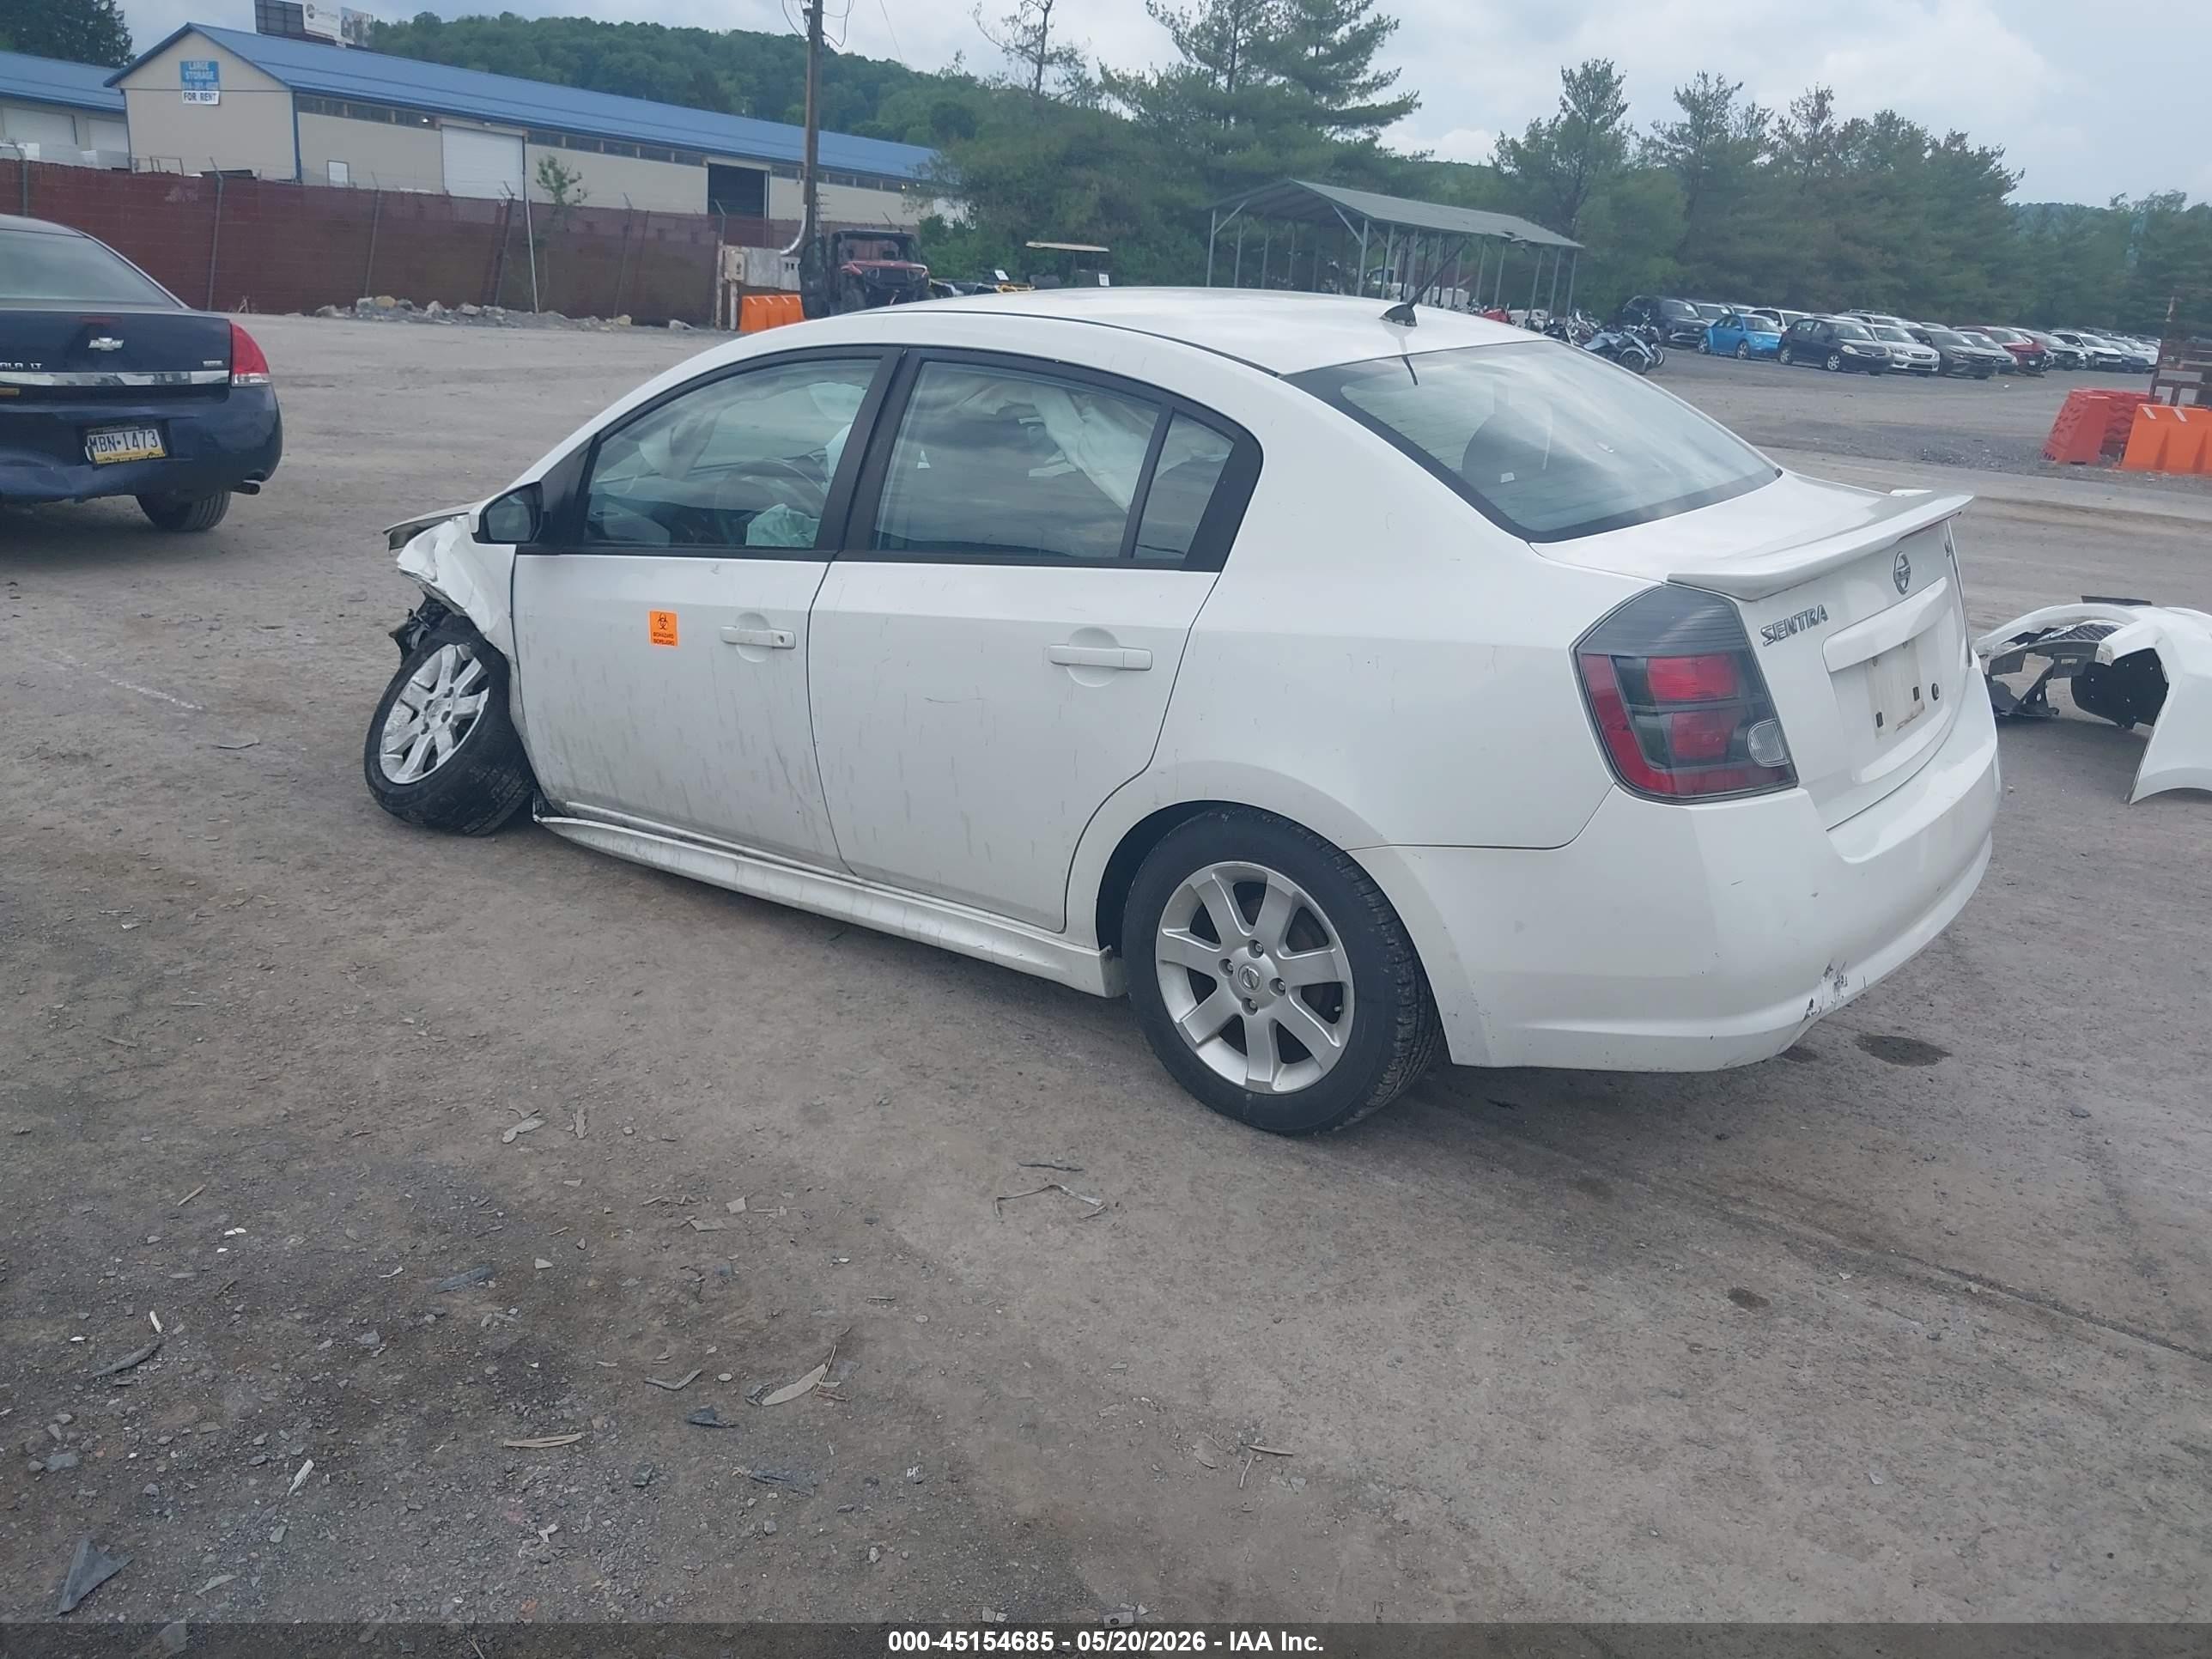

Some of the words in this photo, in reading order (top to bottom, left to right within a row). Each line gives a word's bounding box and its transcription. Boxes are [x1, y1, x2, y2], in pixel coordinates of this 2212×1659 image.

[185, 70, 214, 79] STORAGE
[183, 92, 198, 101] FOR
[199, 93, 216, 101] RENT
[1760, 605, 1828, 647] SENTRA
